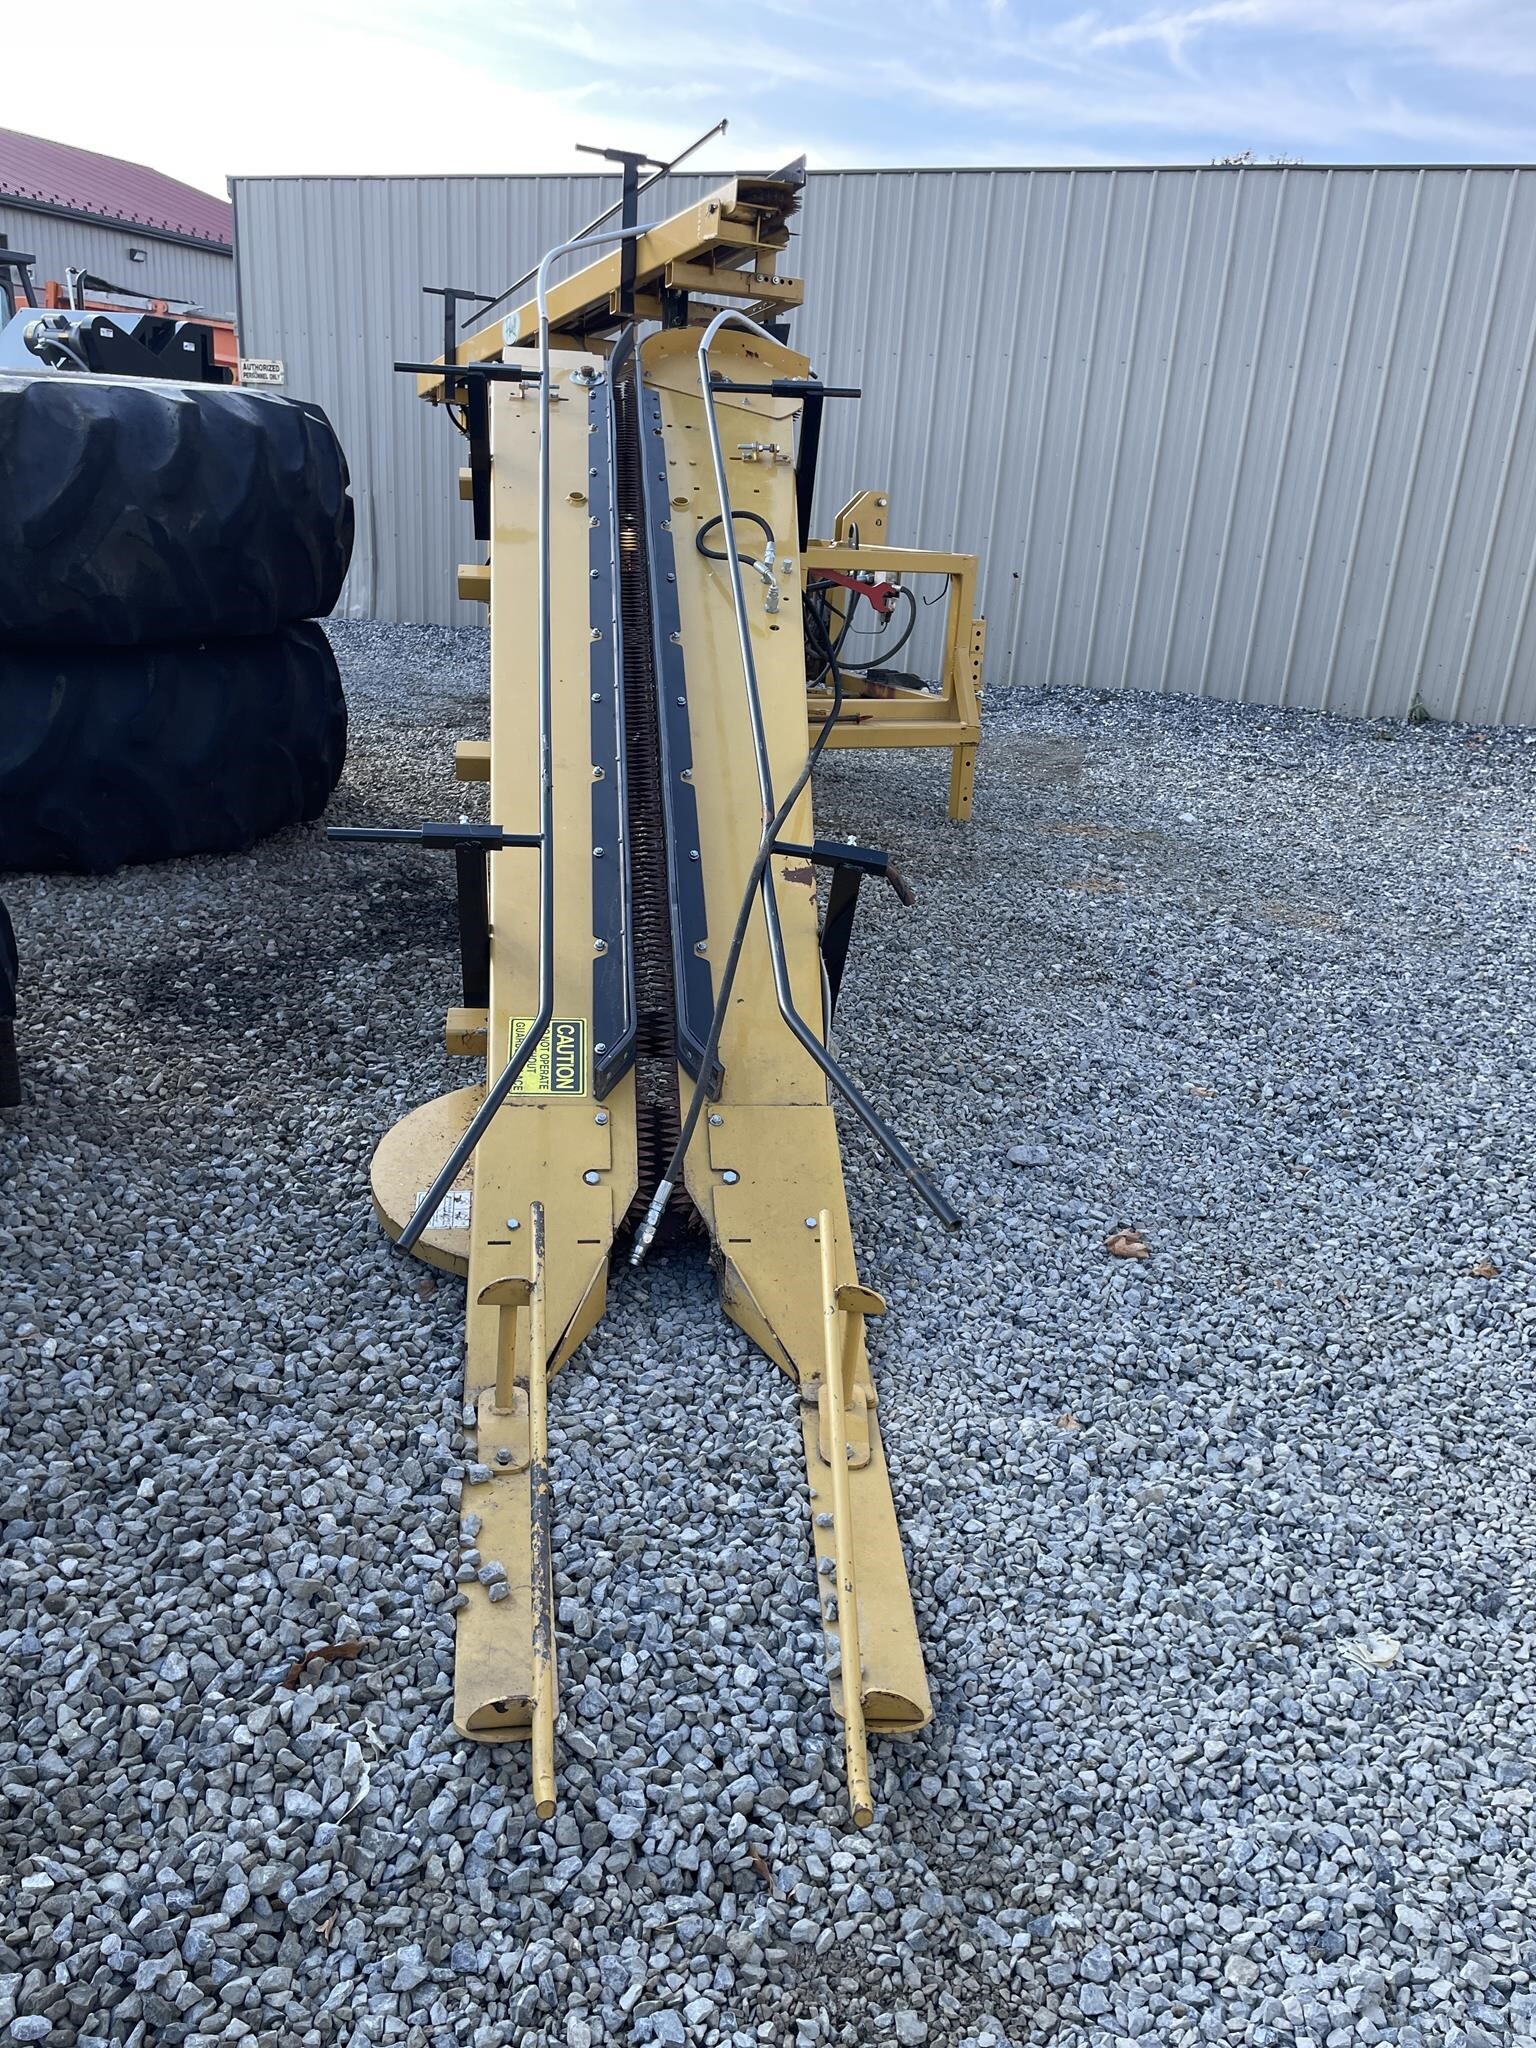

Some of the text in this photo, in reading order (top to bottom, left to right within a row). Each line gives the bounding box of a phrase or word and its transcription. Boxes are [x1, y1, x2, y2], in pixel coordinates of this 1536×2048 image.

[243, 363, 280, 372] AUTHORIZED
[539, 1053, 550, 1090] OPERATE
[555, 1024, 575, 1089] CAUTION
